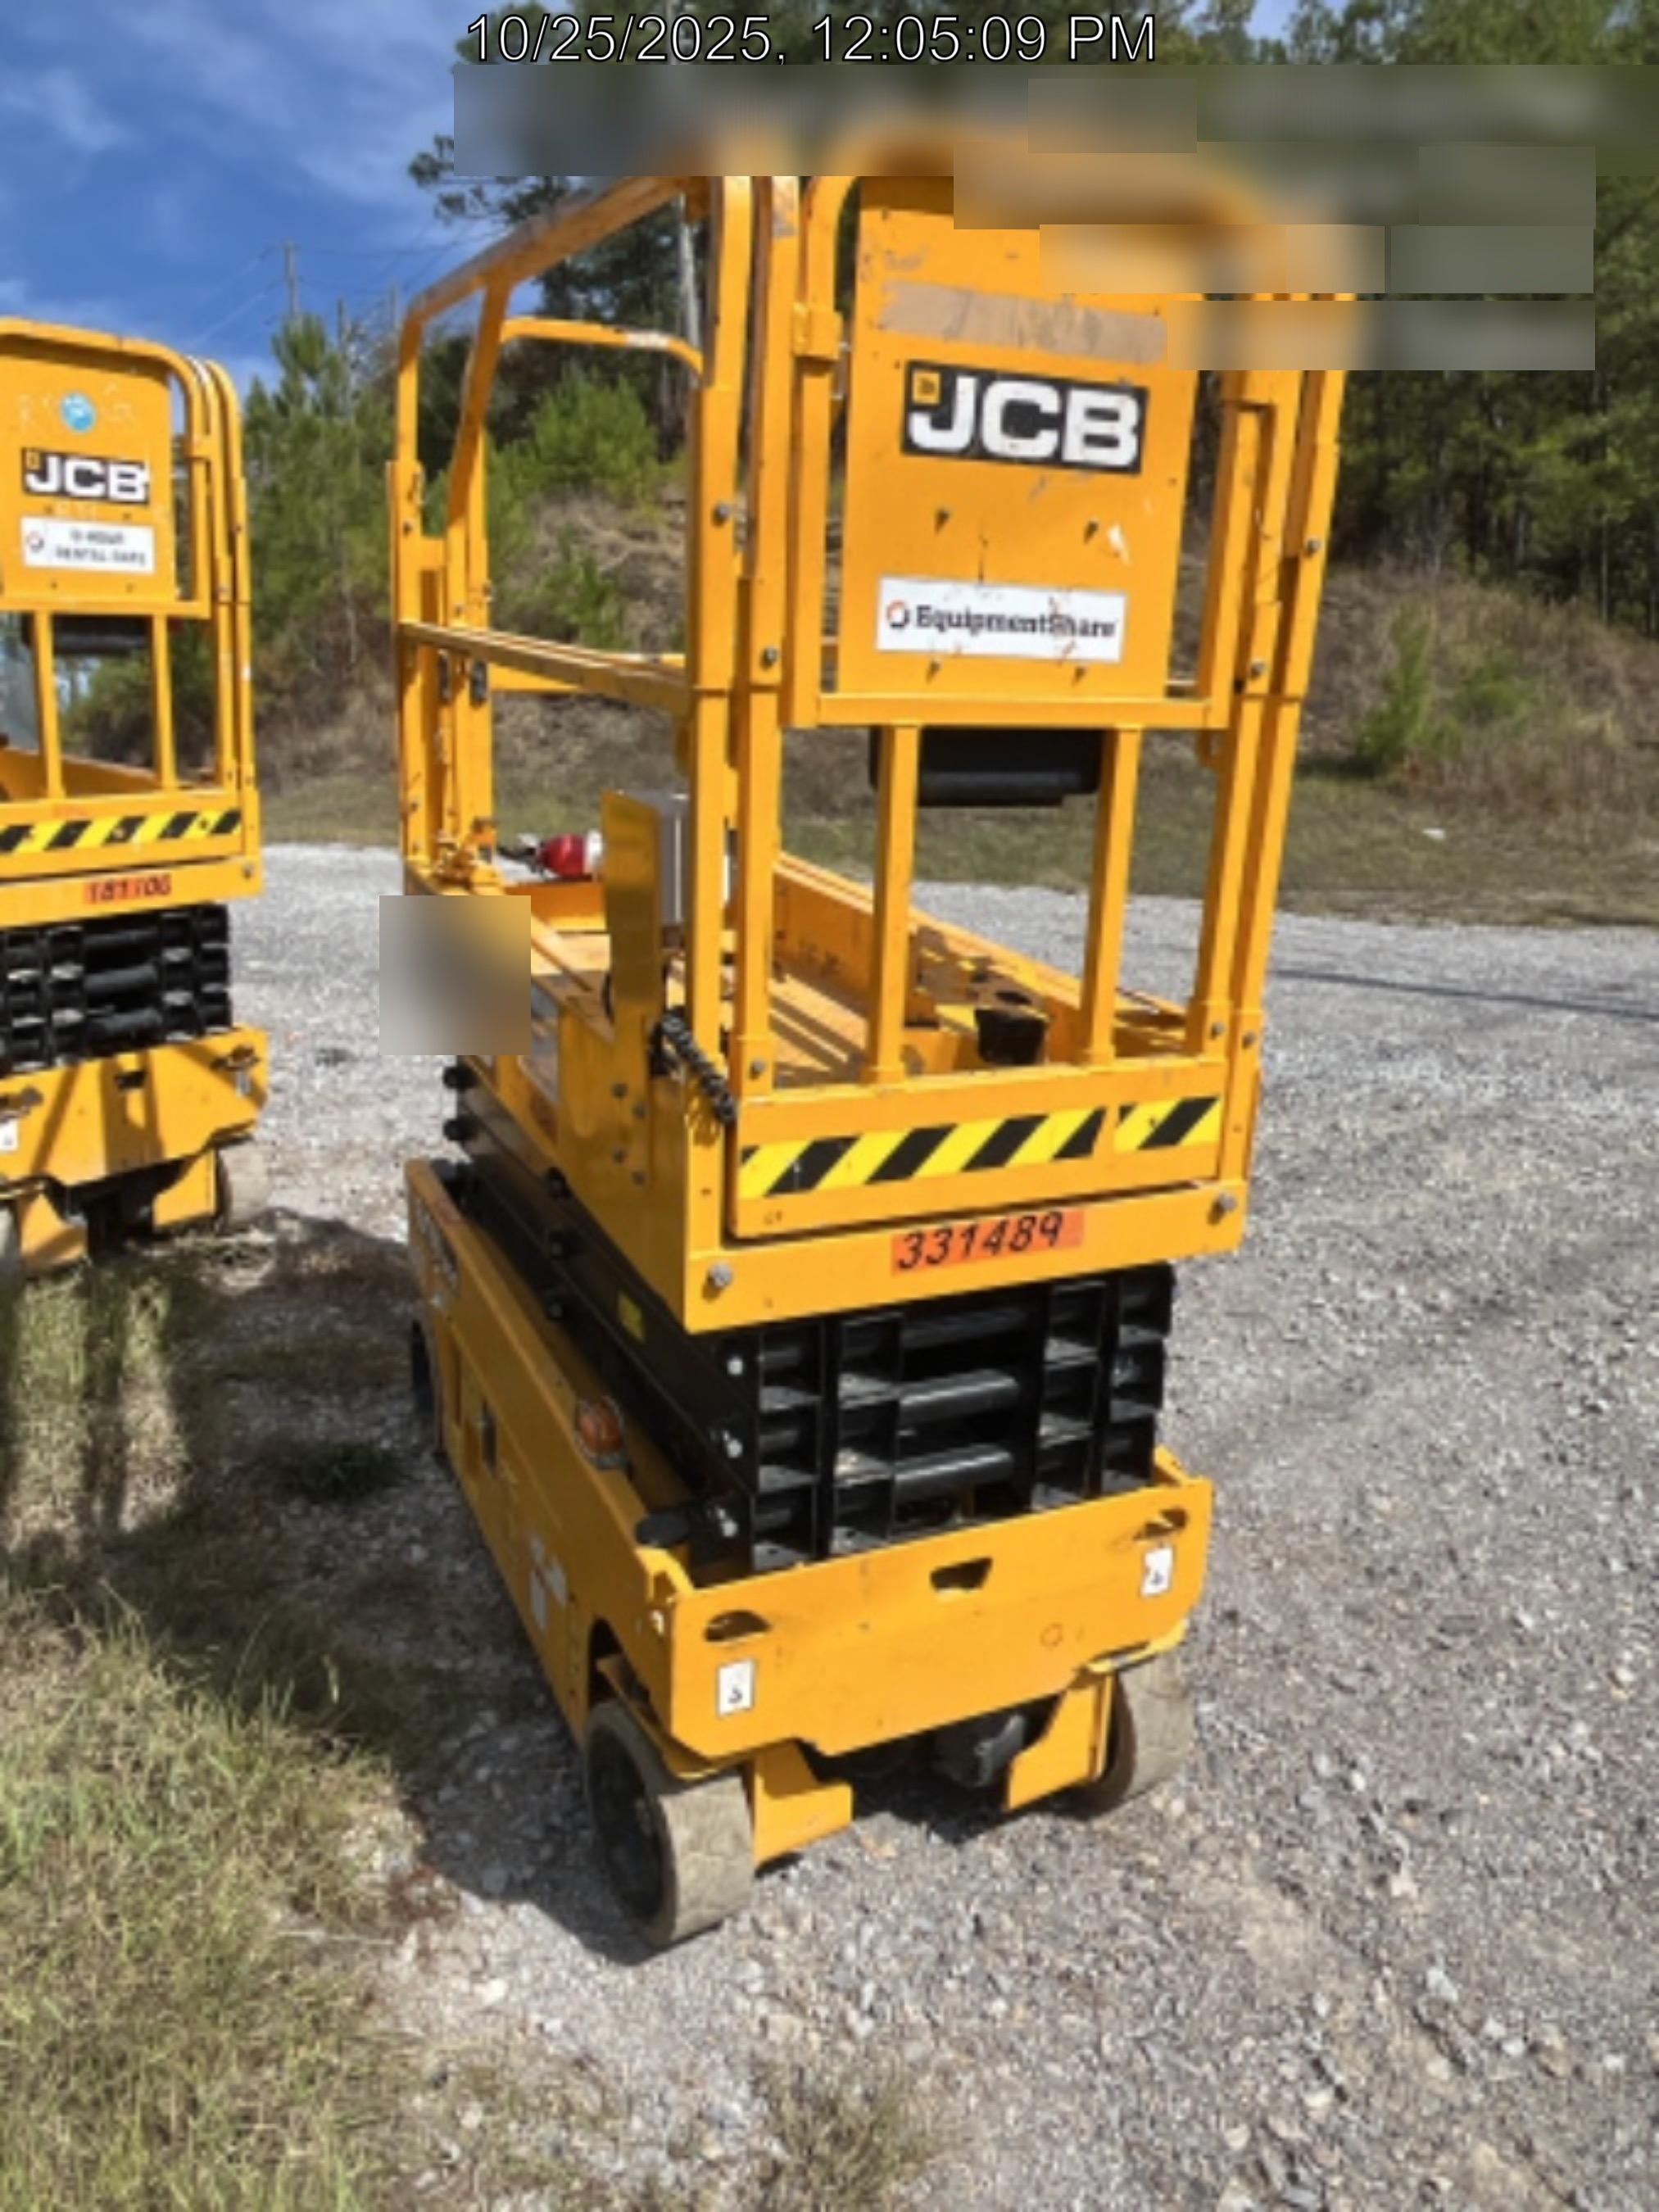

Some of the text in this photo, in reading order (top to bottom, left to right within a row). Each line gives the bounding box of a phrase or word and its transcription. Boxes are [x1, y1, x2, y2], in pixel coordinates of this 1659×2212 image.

[908, 374, 1141, 467] JCB
[25, 455, 149, 502] JCB
[915, 604, 1116, 637] EquipmentShare
[897, 1211, 1063, 1270] 331489
